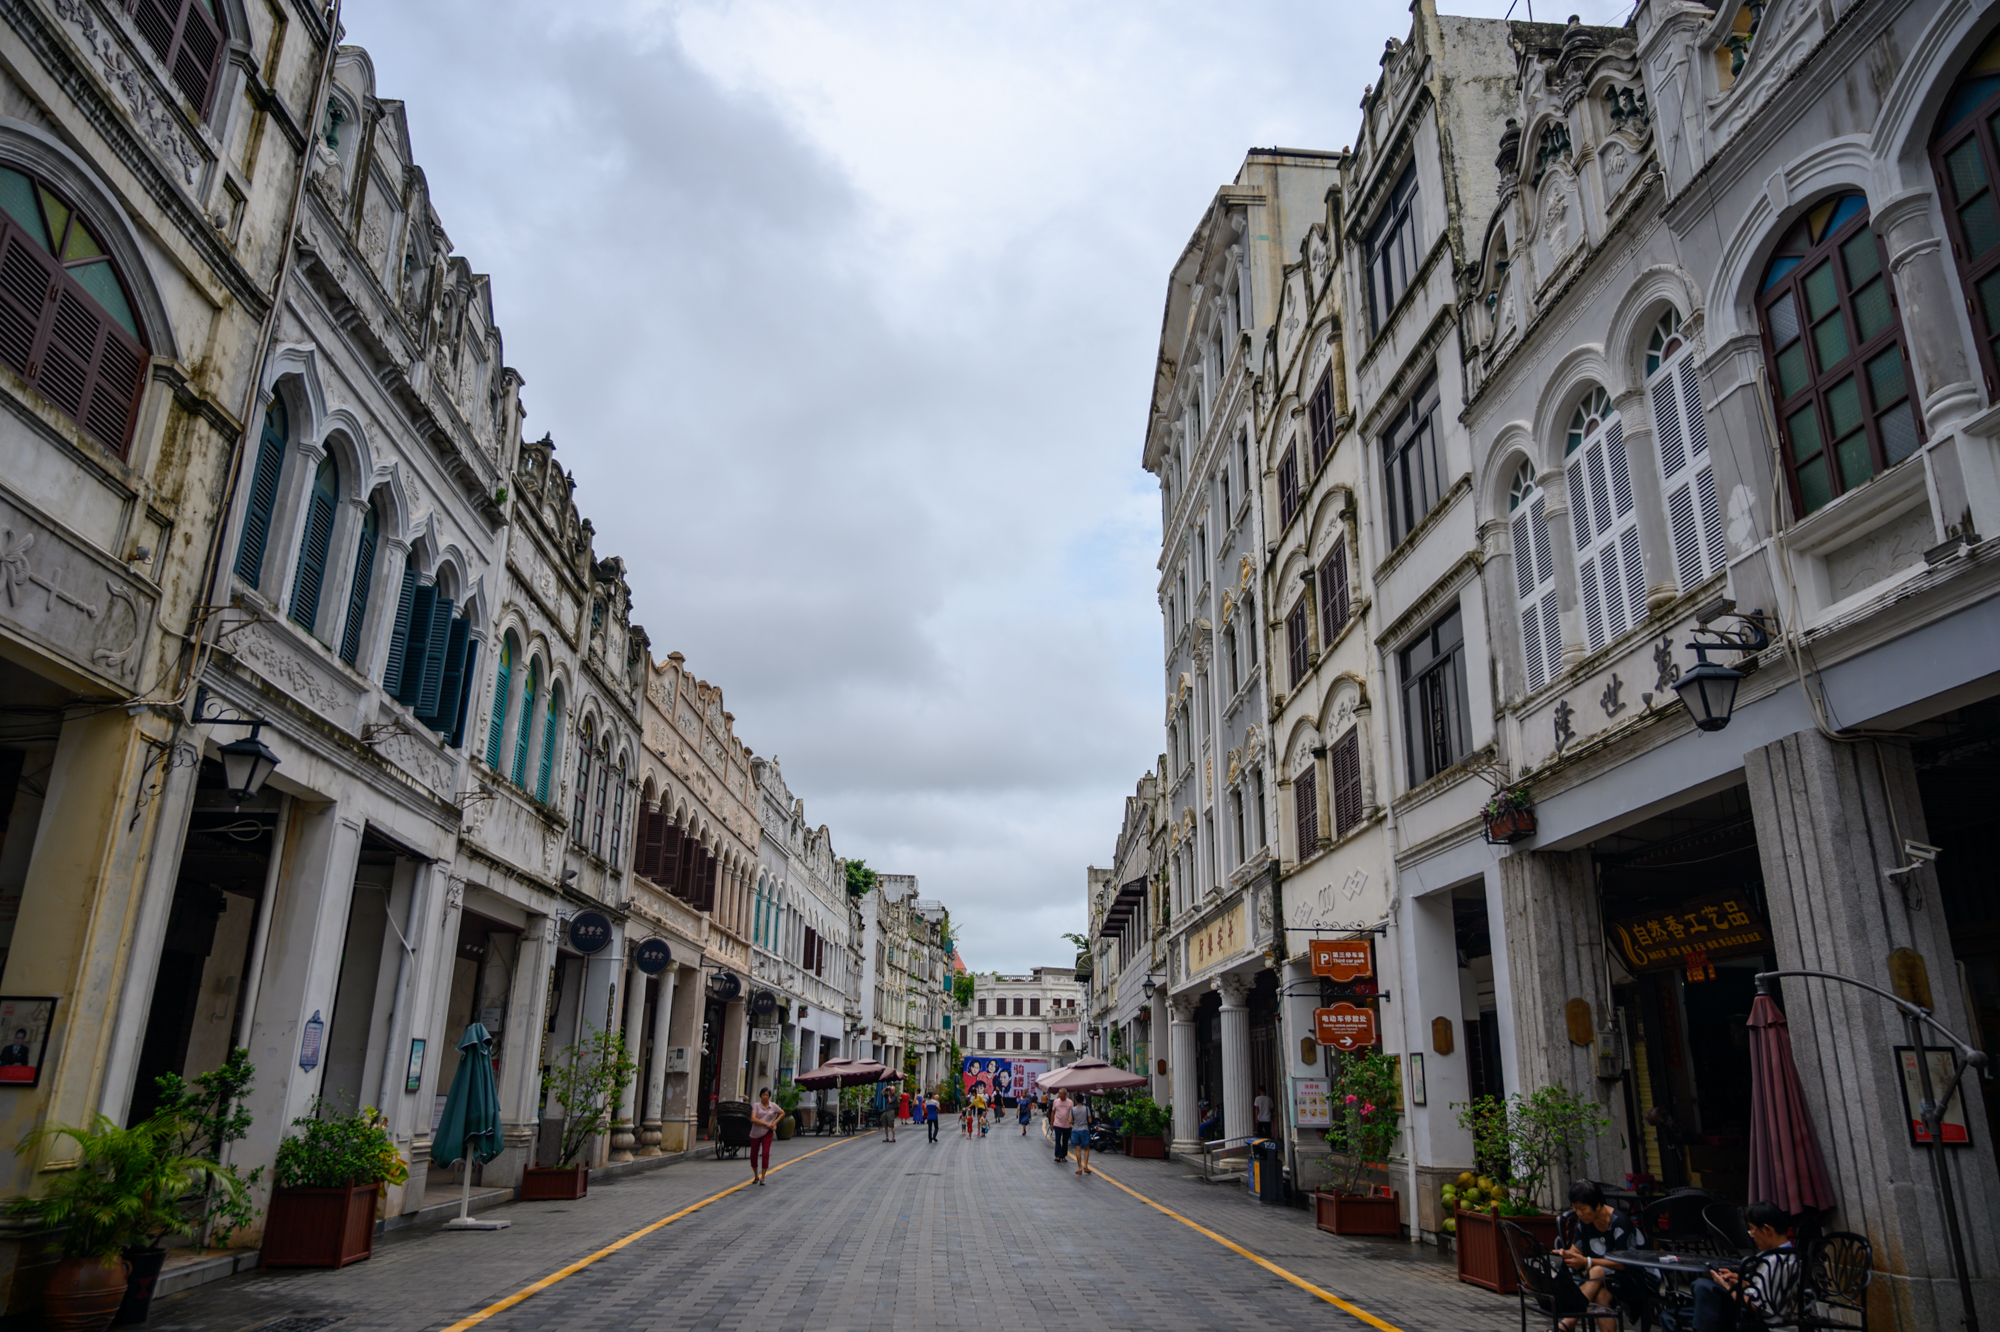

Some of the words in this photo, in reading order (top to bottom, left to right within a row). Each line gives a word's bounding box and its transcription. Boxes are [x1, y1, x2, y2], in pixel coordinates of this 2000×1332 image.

[1632, 900, 1751, 947] 自然香工艺品
[1320, 953, 1329, 965] P
[1321, 1014, 1367, 1023] 电动车停放处
